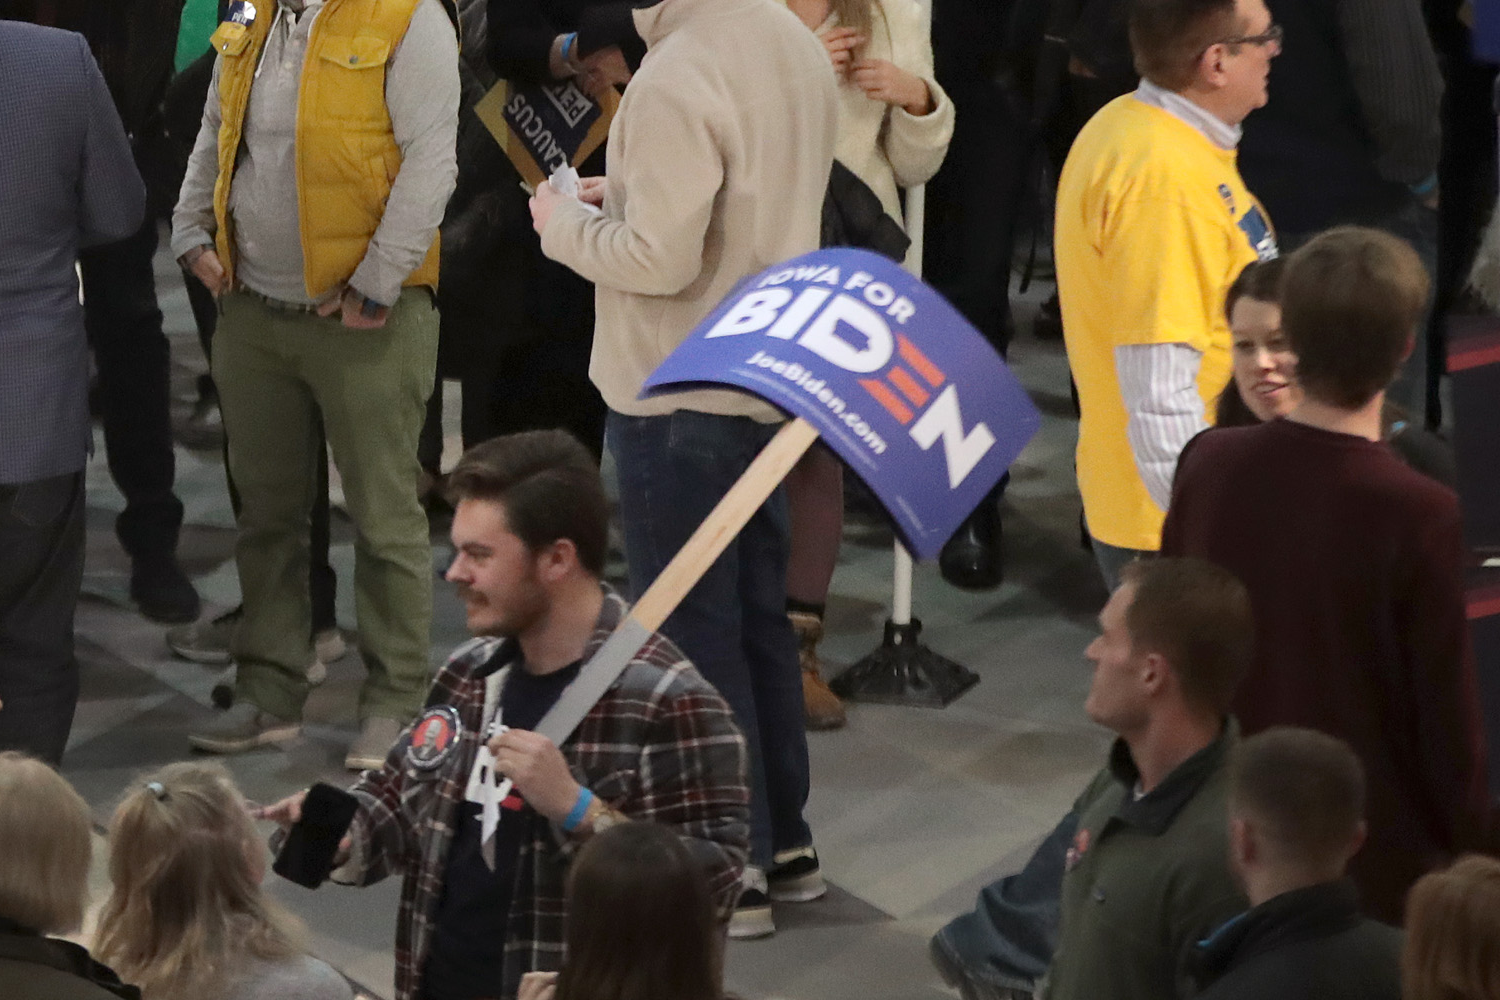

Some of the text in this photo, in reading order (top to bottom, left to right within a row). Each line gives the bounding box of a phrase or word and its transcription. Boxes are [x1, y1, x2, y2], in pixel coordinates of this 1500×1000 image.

[756, 264, 916, 325] IOWA FOR
[704, 286, 997, 490] BIDEN
[745, 350, 888, 455] JoeBiden.com
